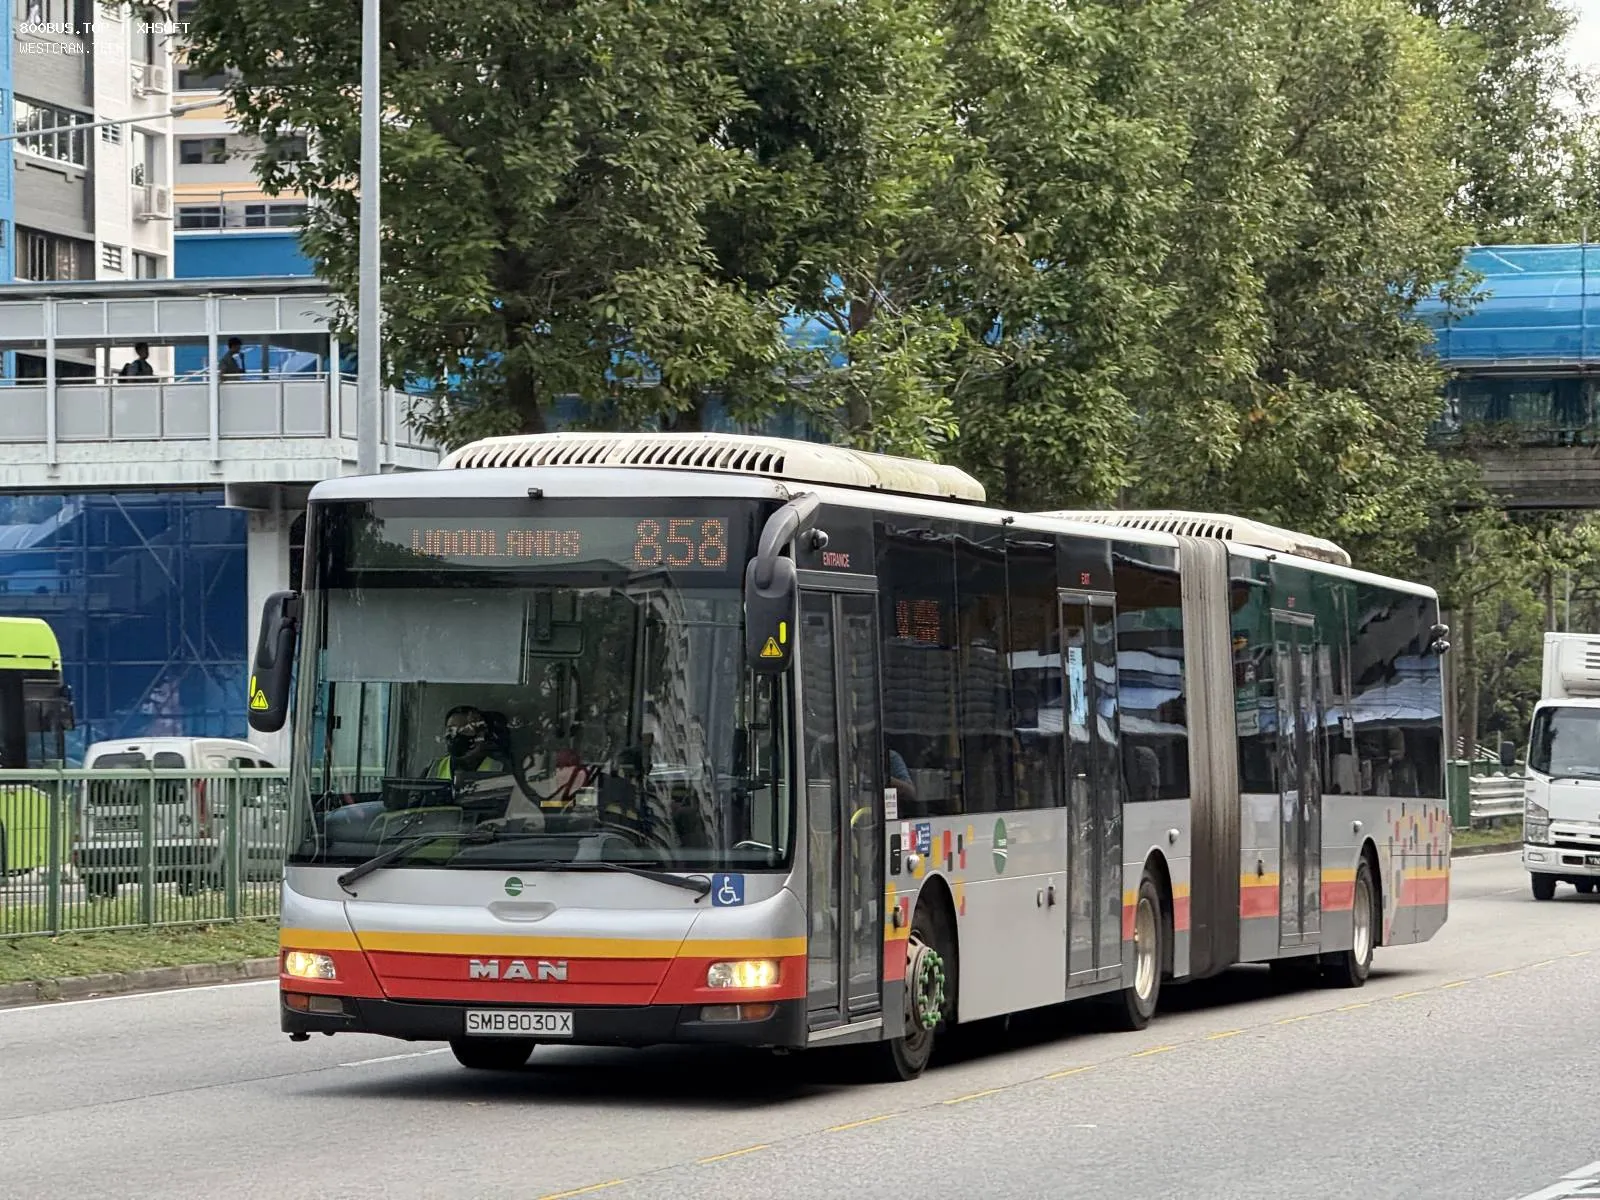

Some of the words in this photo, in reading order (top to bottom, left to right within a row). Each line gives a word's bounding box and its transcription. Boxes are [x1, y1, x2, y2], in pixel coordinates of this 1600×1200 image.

[411, 529, 581, 557] WOODLANDS
[634, 519, 728, 567] 858
[822, 551, 851, 568] ENTRANCE
[469, 959, 569, 981] MAN
[468, 1013, 571, 1031] SMB8030X
